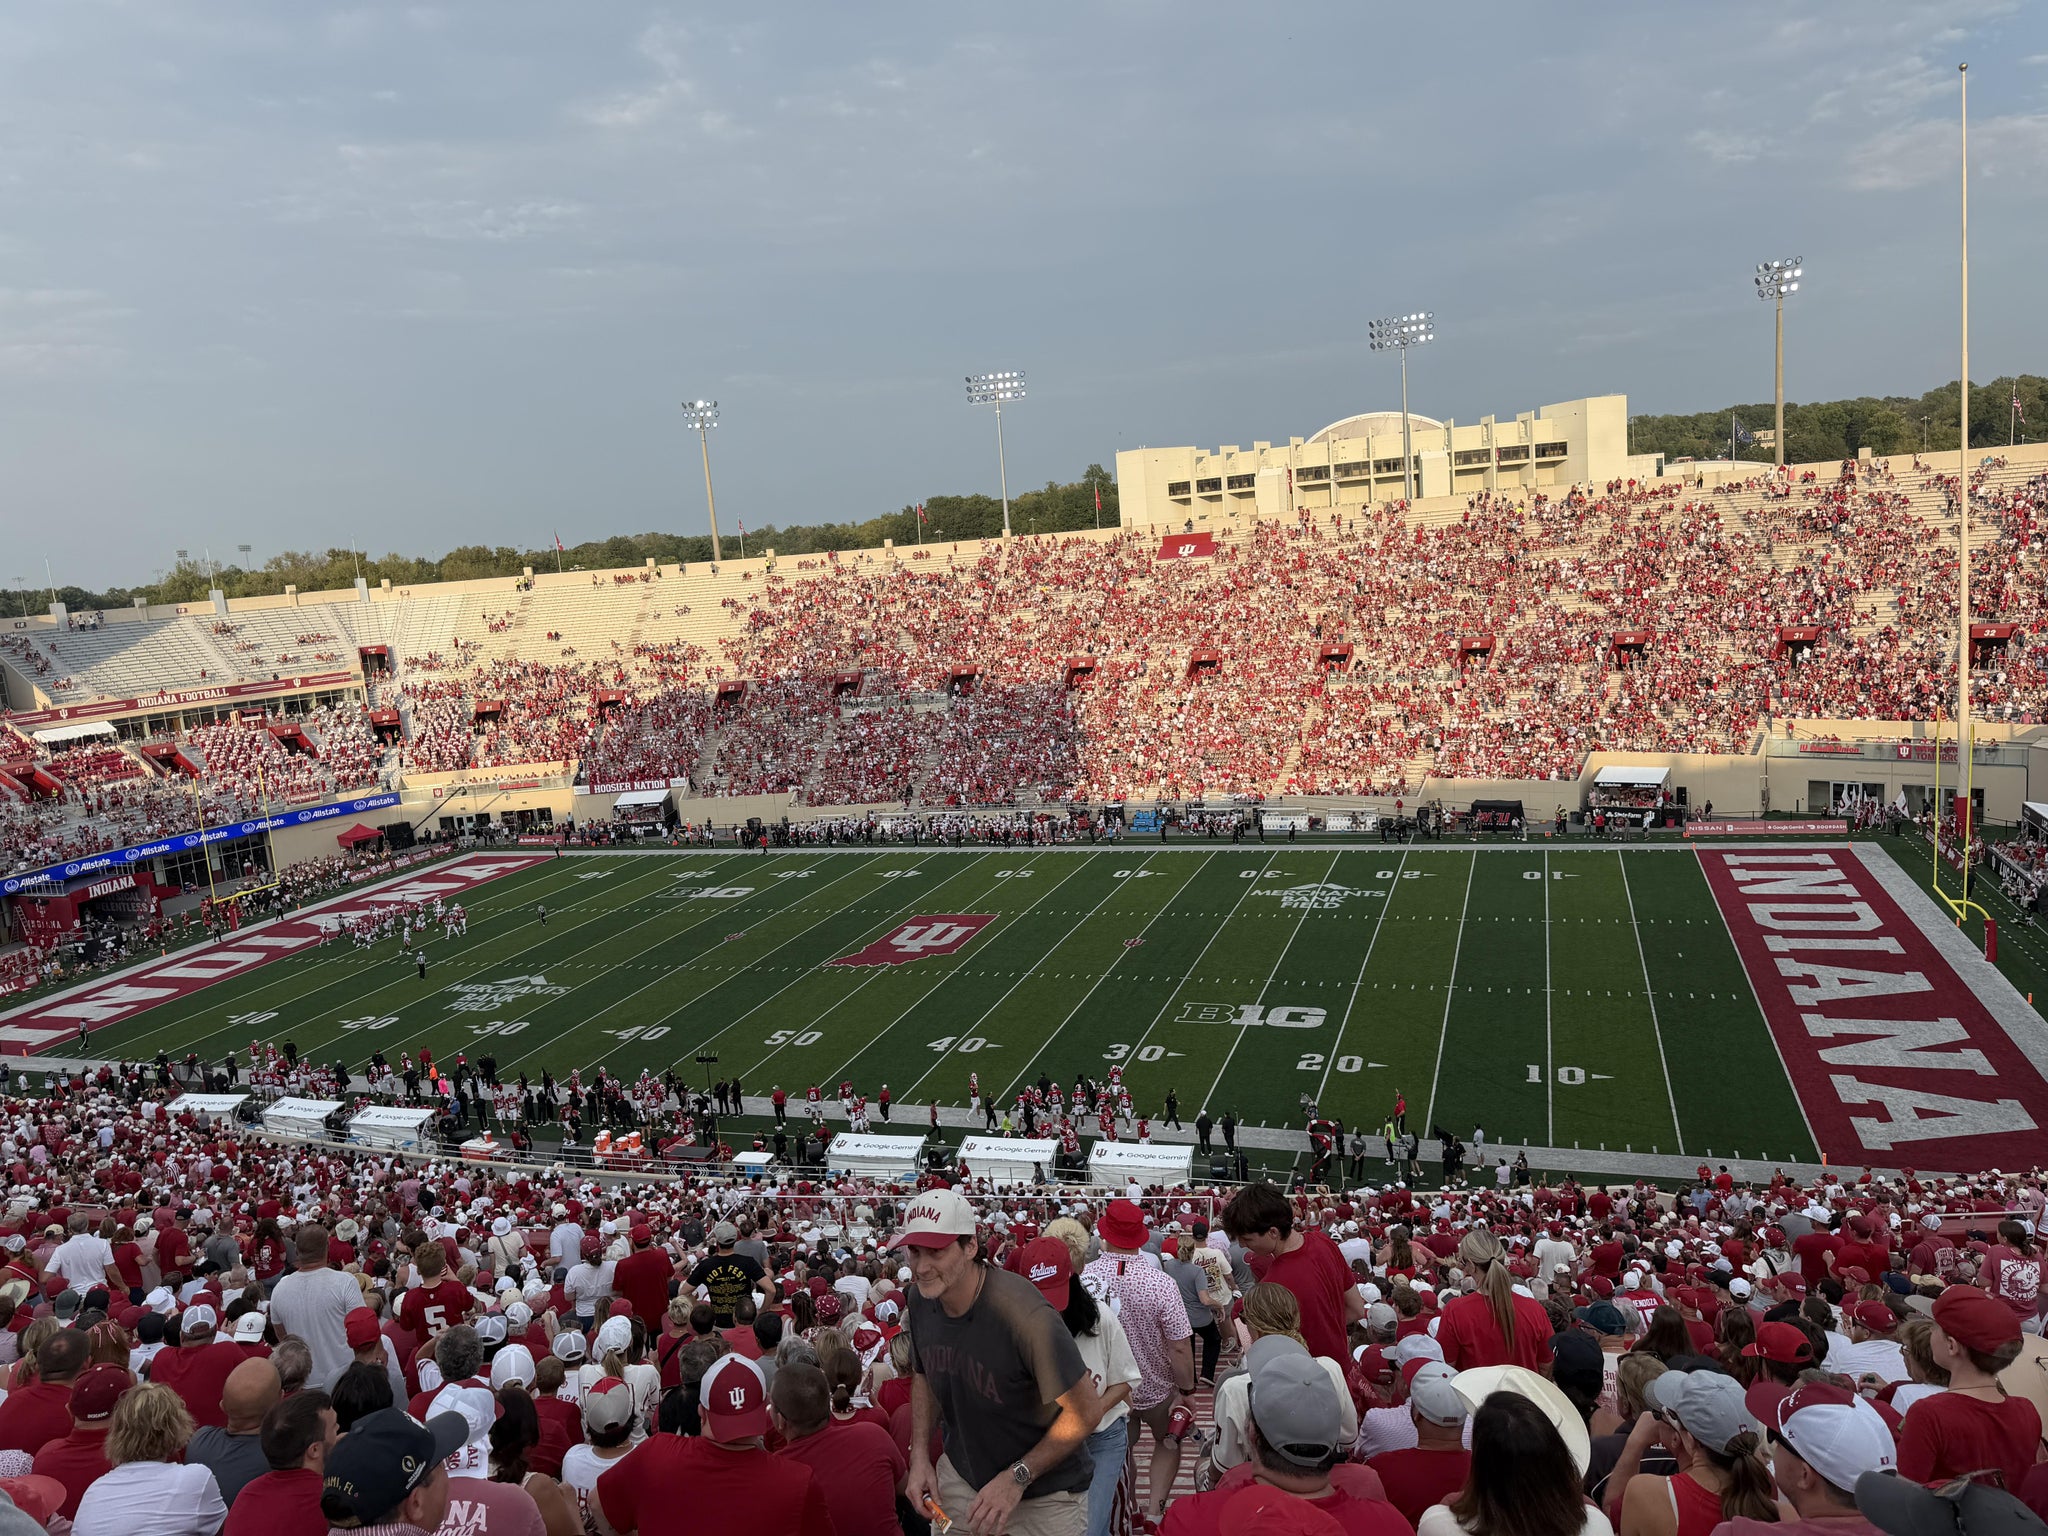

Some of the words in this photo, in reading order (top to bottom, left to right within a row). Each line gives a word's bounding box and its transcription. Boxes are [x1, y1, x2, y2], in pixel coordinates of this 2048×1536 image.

[137, 694, 178, 708] INDIANA
[180, 687, 229, 703] FOOTBALL
[594, 782, 631, 793] HOOSIER
[634, 780, 666, 790] NATION
[367, 796, 394, 808] Allstate
[312, 807, 340, 819] Allstate
[255, 818, 284, 831] Allstate
[198, 830, 228, 843] Allstate
[140, 843, 170, 857] Allstate
[80, 858, 111, 872] Allstate
[19, 873, 51, 888] Allstate
[88, 876, 136, 898] INDIANA
[1250, 889, 1386, 897] MERCHANTS
[1280, 901, 1340, 909] FIELD
[444, 984, 571, 995] MERCHANTS
[457, 993, 525, 1003] BANK
[1722, 853, 2040, 1151] INDIANA
[442, 1001, 502, 1012] FIELD
[237, 1011, 280, 1025] 10
[344, 1016, 399, 1030] 20
[473, 1021, 531, 1036] 30
[613, 1026, 671, 1041] 40
[764, 1030, 824, 1046] 50
[927, 1036, 986, 1054] 40
[1102, 1043, 1167, 1062] 30
[1297, 1053, 1364, 1073] 20
[1525, 1064, 1586, 1085] 10
[863, 1142, 891, 1151] Google
[894, 1143, 919, 1151] Gemini
[995, 1144, 1024, 1154] Google
[1026, 1146, 1053, 1154] Gemini
[1126, 1151, 1156, 1161] Google
[1158, 1153, 1189, 1161] Gemini
[706, 1265, 723, 1284] RIOT
[727, 1264, 747, 1282] FEST
[1029, 1262, 1058, 1282] Indiana
[425, 1304, 451, 1337] 5
[343, 1481, 355, 1496] FL
